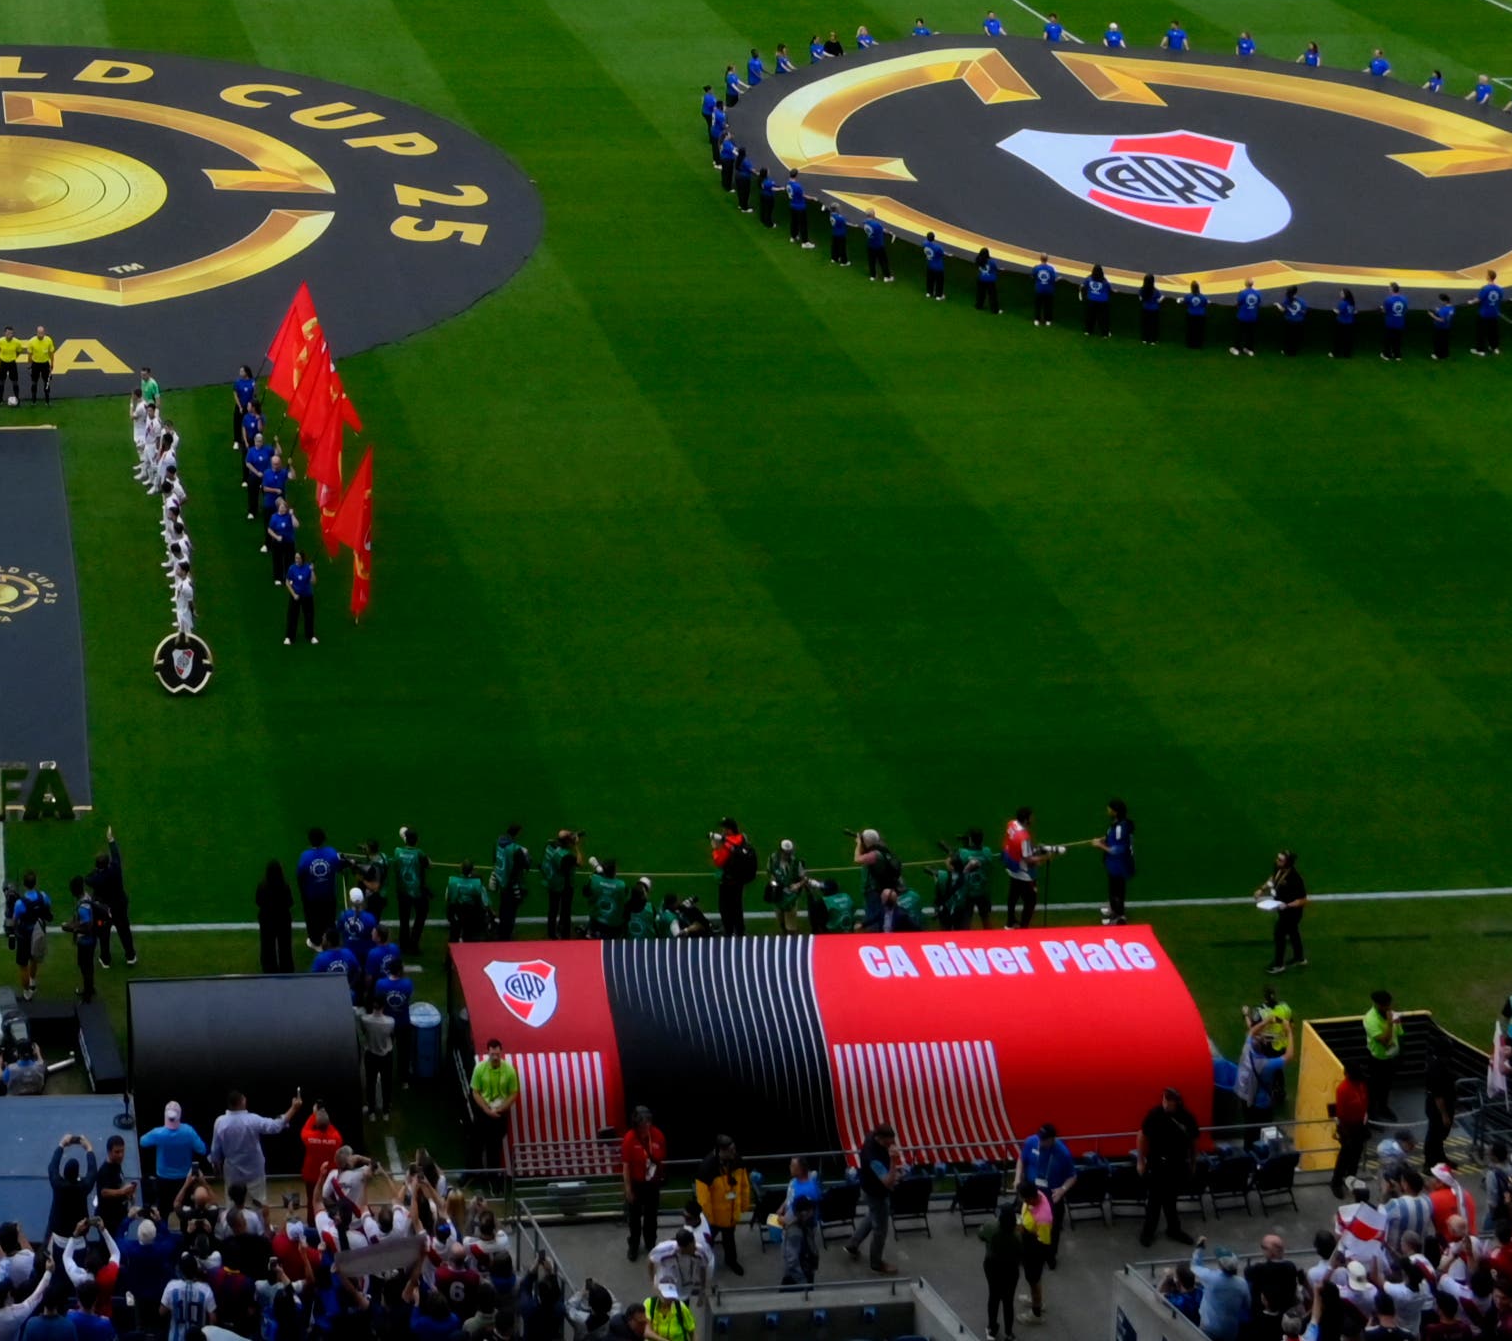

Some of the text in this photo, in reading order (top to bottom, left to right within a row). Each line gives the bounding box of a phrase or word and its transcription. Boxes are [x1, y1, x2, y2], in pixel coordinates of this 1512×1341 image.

[219, 82, 440, 159] CUP
[388, 181, 490, 249] 25
[26, 569, 56, 590] CUP
[42, 589, 59, 609] 25
[859, 936, 1158, 979] CA River Plate
